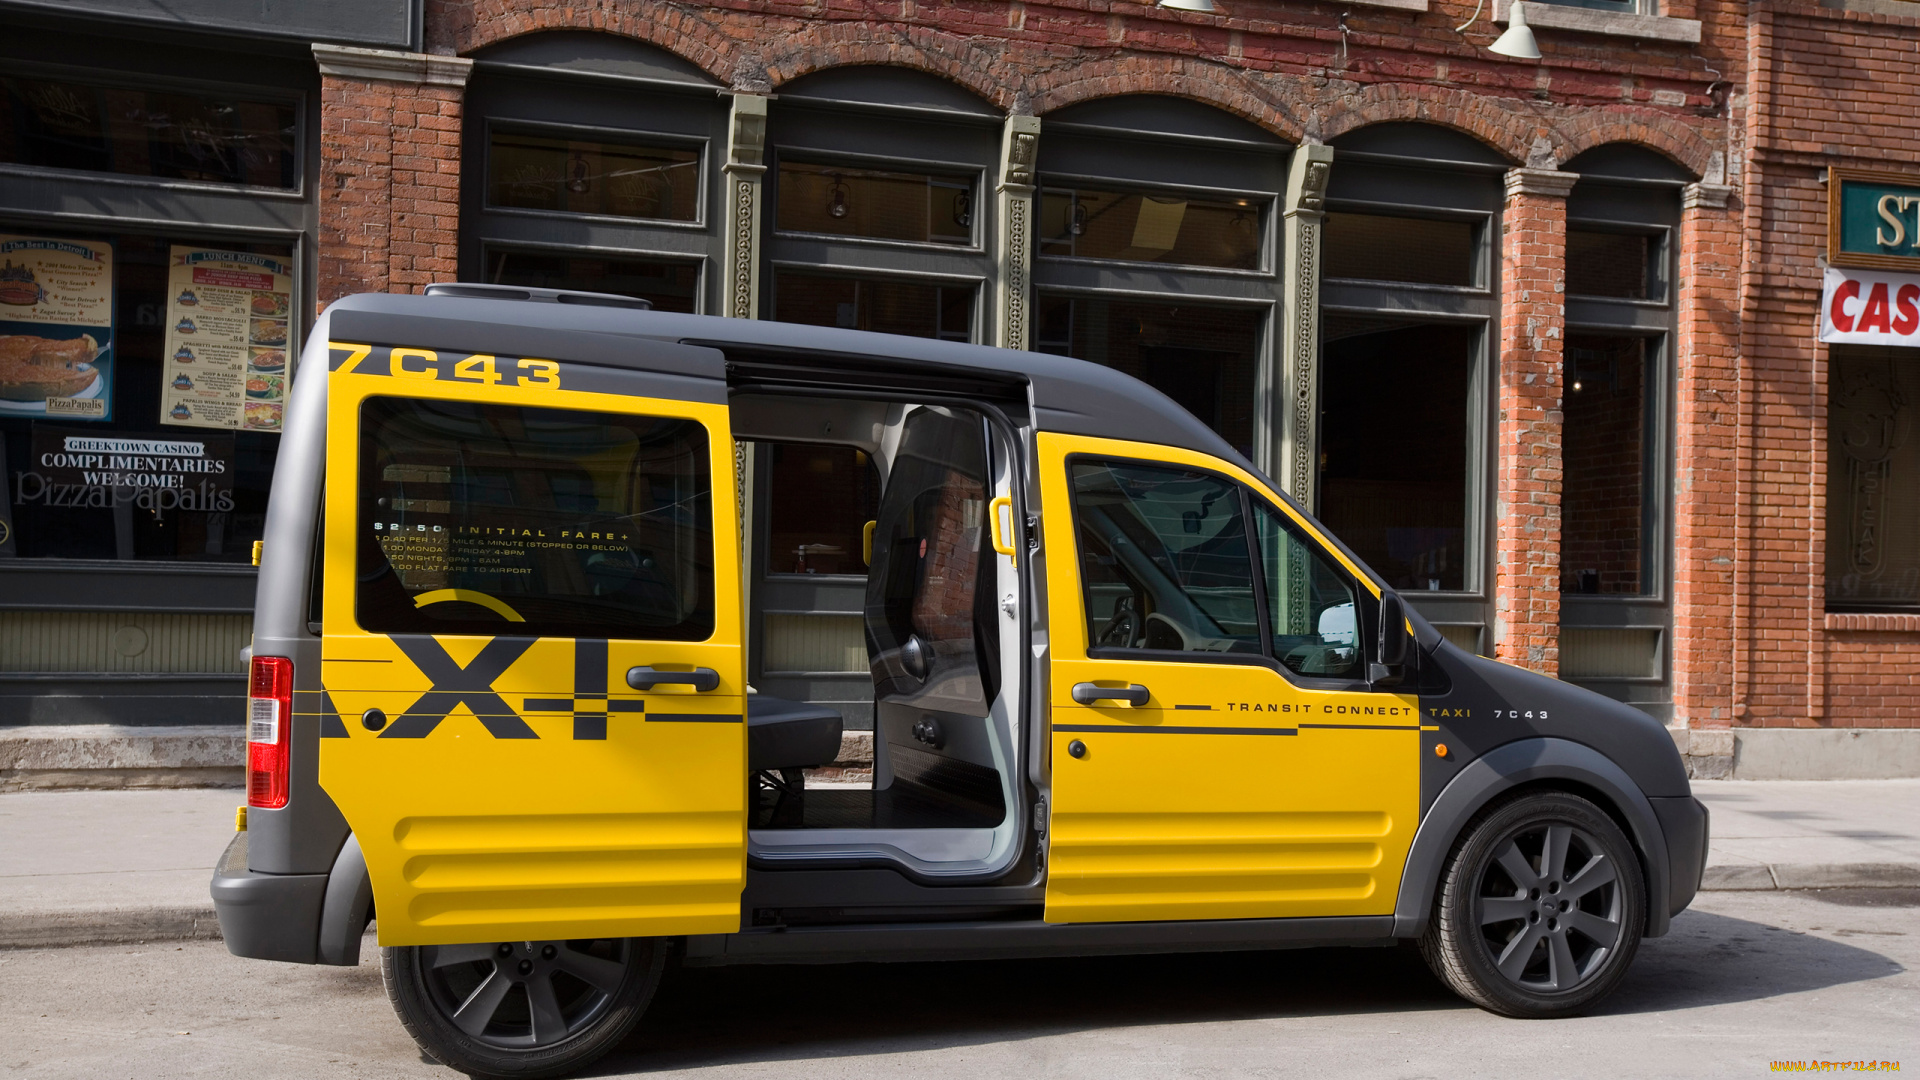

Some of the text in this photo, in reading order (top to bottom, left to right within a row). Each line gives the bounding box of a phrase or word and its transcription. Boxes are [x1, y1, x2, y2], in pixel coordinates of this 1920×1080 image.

[27, 241, 44, 249] Best
[57, 242, 86, 255] Detroit
[203, 253, 266, 266] LUNCH MENU
[1830, 279, 1920, 336] CAS
[329, 342, 560, 390] 7C43
[49, 398, 102, 411] PizzaPapalis
[69, 440, 200, 455] GREEKTOWN CASINO
[41, 453, 225, 474] COMPLIMENTARIES
[83, 471, 184, 488] WELCOME!
[14, 471, 235, 521] PizzaPapalis
[459, 526, 546, 537] INITIAL
[406, 545, 448, 553] MONDAY
[487, 539, 524, 547] MINUTE
[526, 541, 573, 550] (STOPPED
[592, 544, 629, 552] BELOW)
[320, 635, 608, 740] XI
[1227, 703, 1548, 720] TRANSIT CONNECT TAXI 7C43
